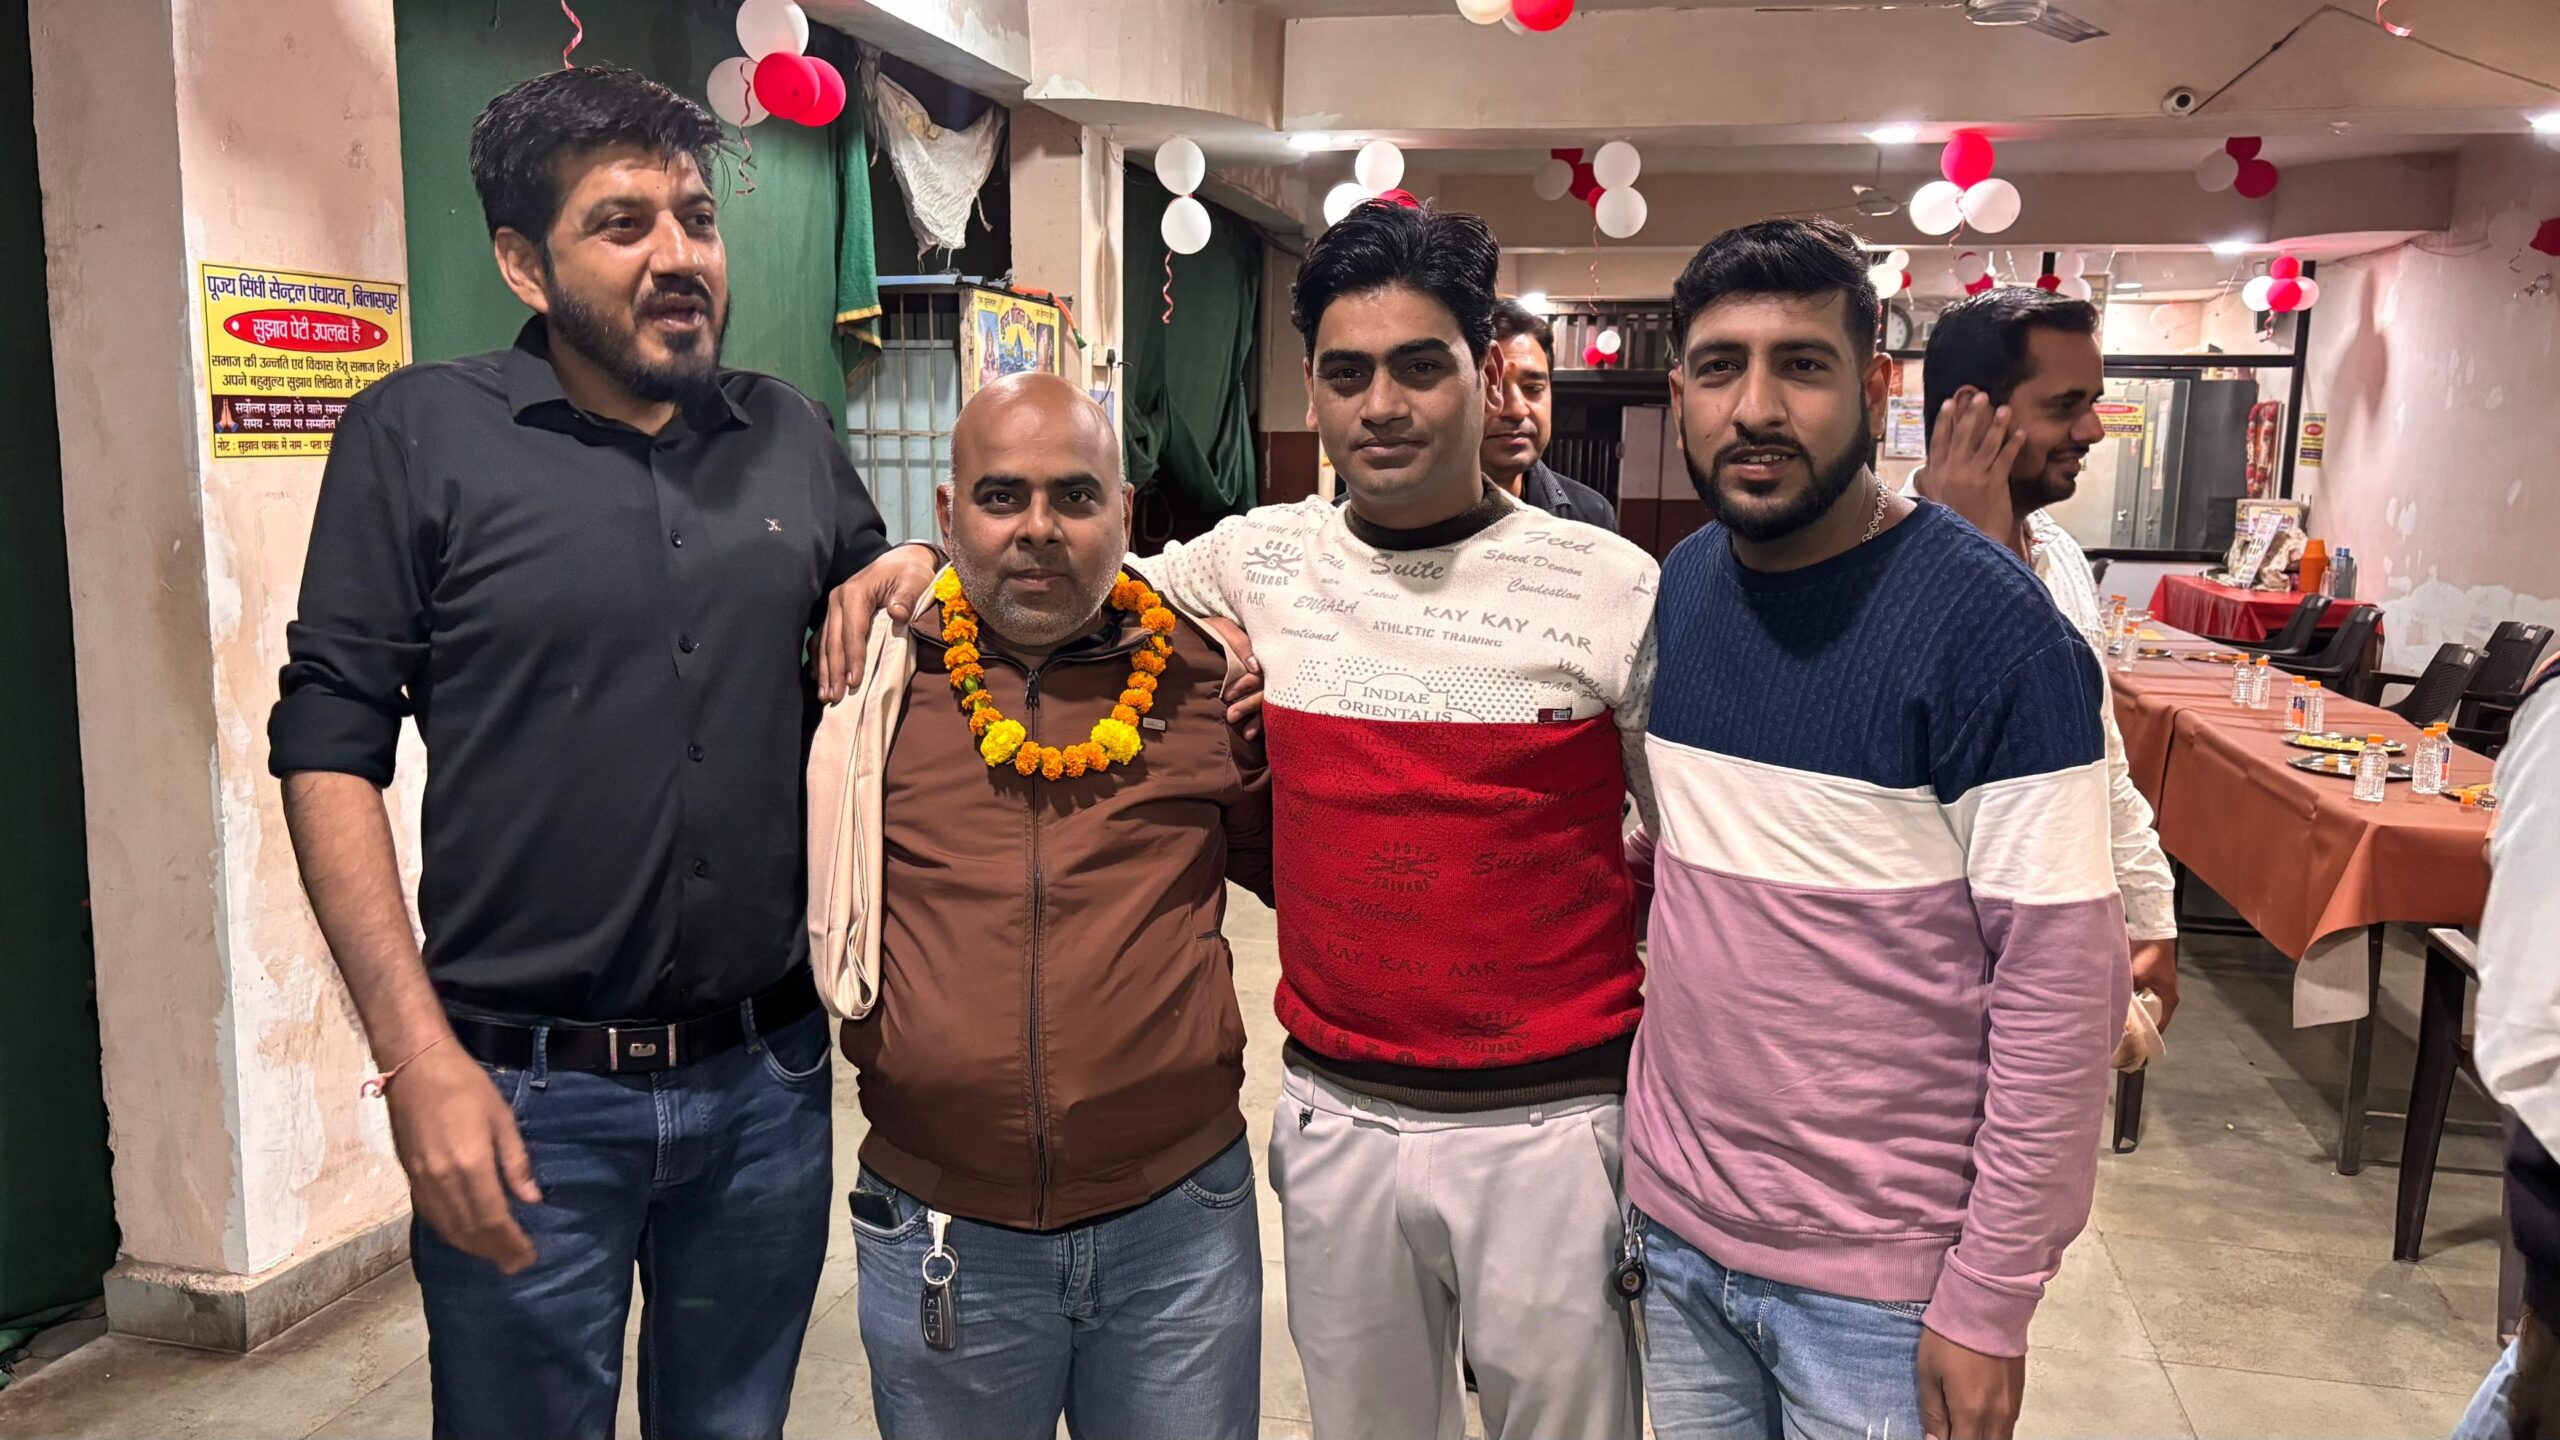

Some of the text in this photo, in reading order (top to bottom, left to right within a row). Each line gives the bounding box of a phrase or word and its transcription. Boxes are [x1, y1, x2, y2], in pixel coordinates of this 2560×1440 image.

[207, 276, 236, 300] पूज्य
[268, 276, 306, 303] सेन्ट्रल
[353, 284, 398, 315] बिलासपुर
[252, 314, 361, 344] सुझाव पेटी उपलब्ध है
[211, 355, 240, 367] समाज
[243, 354, 257, 368] की
[259, 355, 289, 369] उन्नति
[306, 356, 333, 371] विकास
[350, 361, 375, 373] समाज
[222, 372, 247, 386] अपने
[287, 376, 312, 391] सुझाव
[314, 374, 342, 389] लिखित
[268, 403, 291, 418] सुझाव
[243, 418, 263, 429] समय
[272, 418, 291, 429] समय
[293, 418, 303, 430] पर
[289, 440, 302, 450] नाम
[1524, 531, 1596, 555] Feed
[1370, 553, 1445, 580] Suite
[1483, 549, 1583, 577] Speed Demon
[1372, 621, 1503, 648] ATHLETIC TRAINING
[1423, 606, 1592, 654] KAY KAY AAR
[1363, 686, 1430, 705] INDIAE
[1338, 699, 1453, 723] ORIENTALIS
